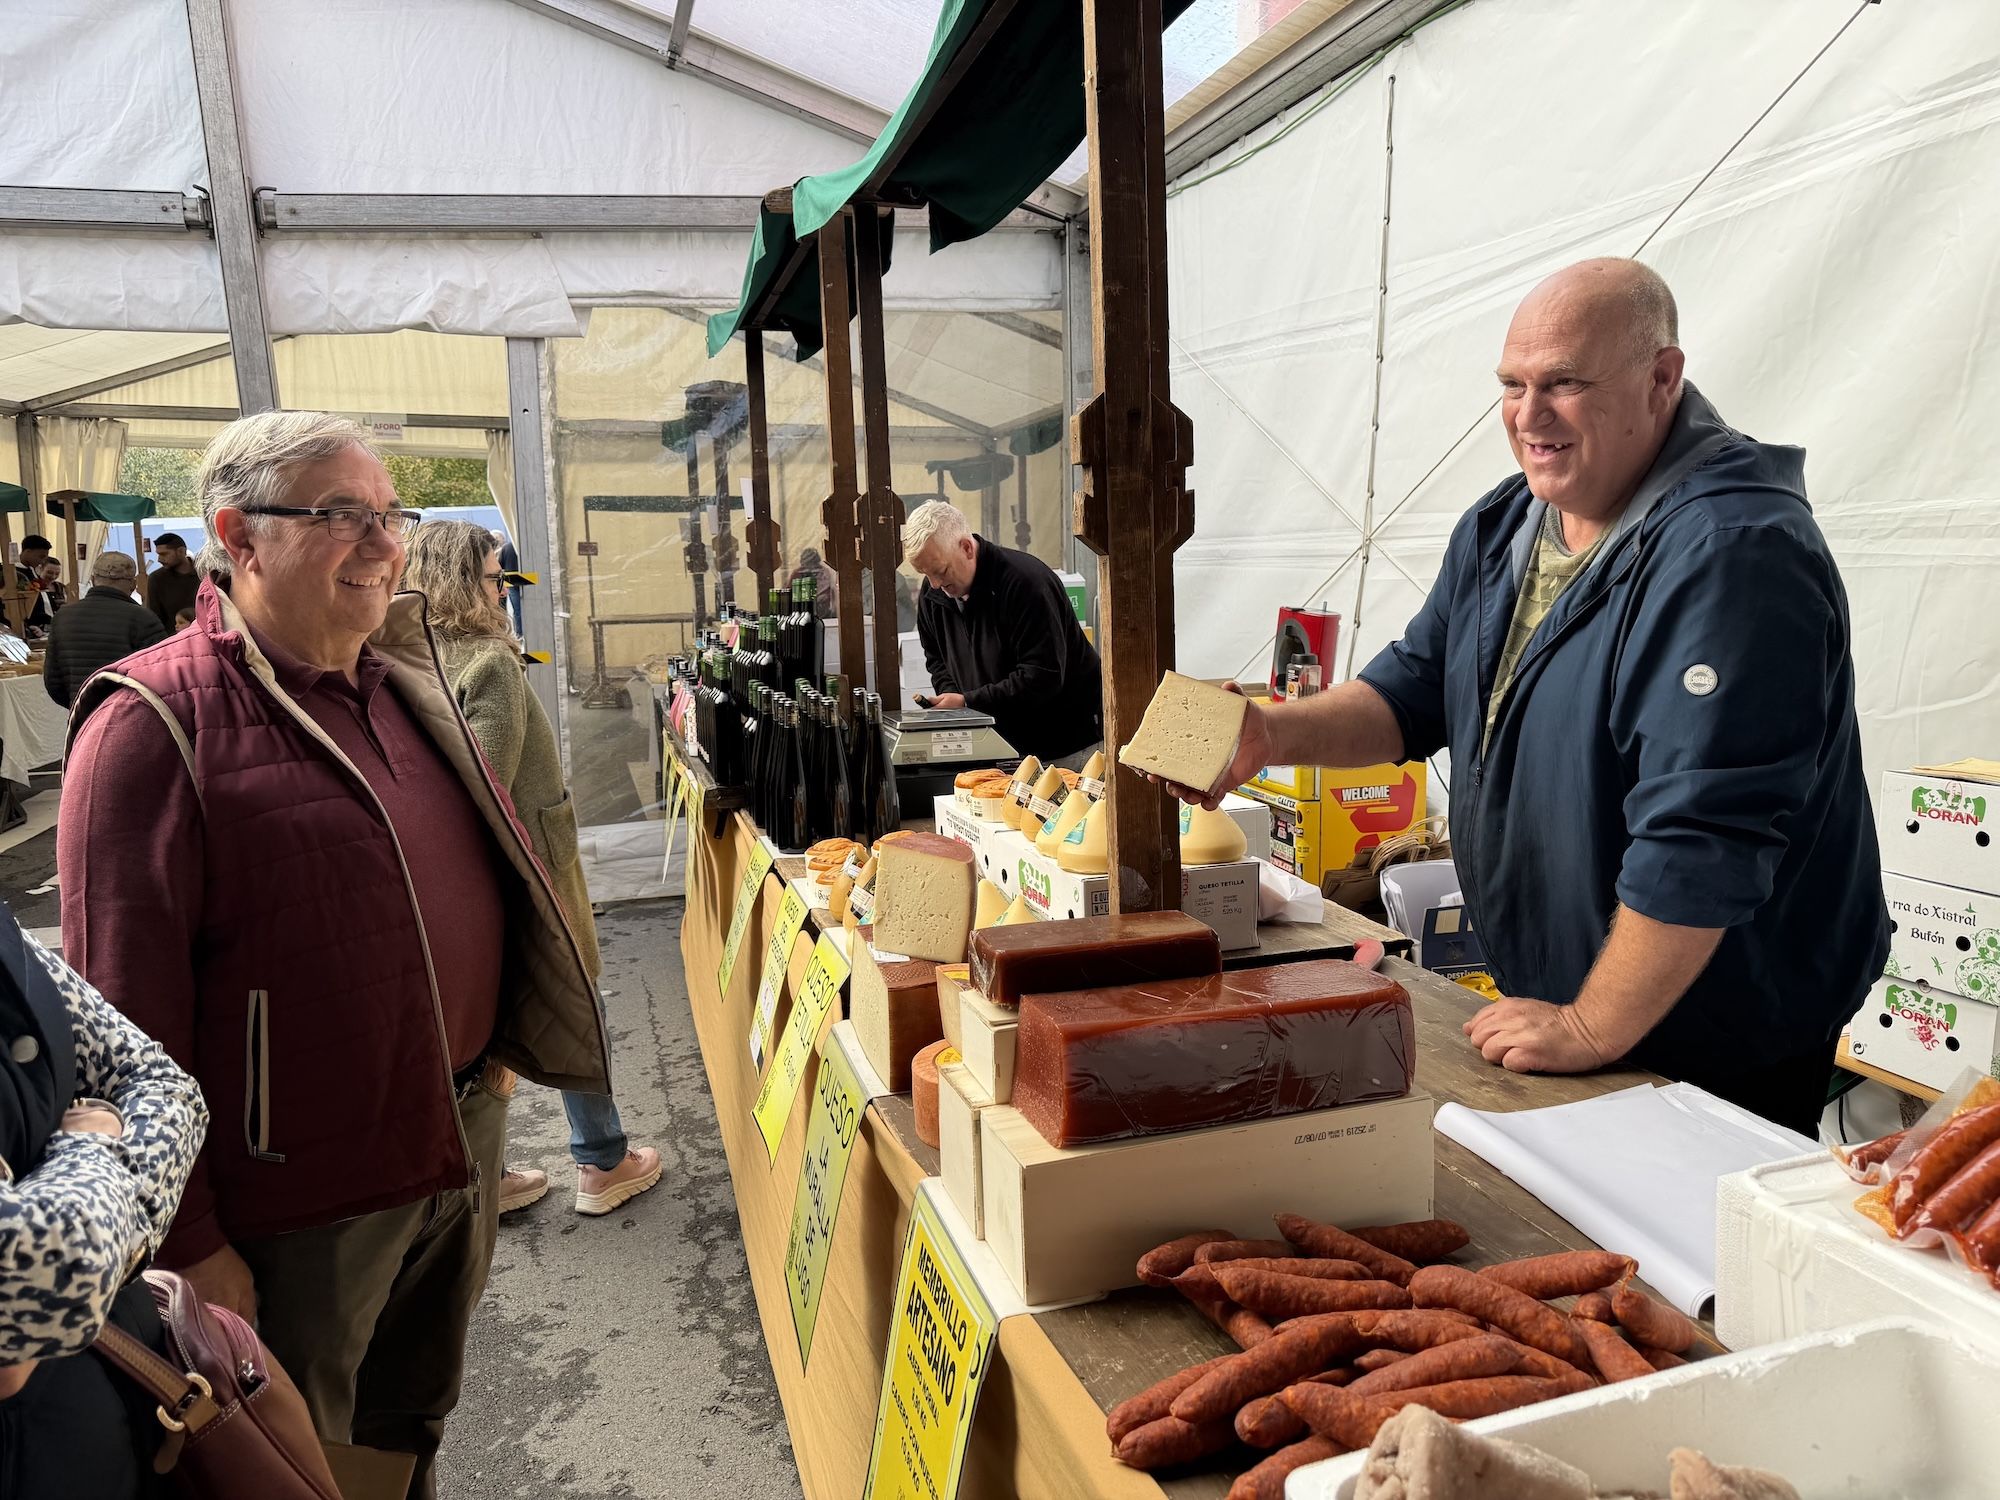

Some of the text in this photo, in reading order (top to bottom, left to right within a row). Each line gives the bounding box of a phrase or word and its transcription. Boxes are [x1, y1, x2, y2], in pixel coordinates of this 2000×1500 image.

[374, 423, 400, 431] AFORO
[1342, 785, 1390, 801] WELCOME
[1917, 806, 1979, 826] LORAN
[1199, 882, 1219, 890] QUESO
[1893, 900, 1976, 927] rra do Xistral
[1911, 927, 1945, 945] Bufón
[806, 956, 835, 1012] QUESO
[793, 995, 814, 1050] TETILLA
[1890, 1005, 1950, 1033] LORAN
[820, 1058, 853, 1149] QUESO
[1294, 1132, 1327, 1145] 07/08/27
[1346, 1125, 1366, 1137] 25219
[820, 1136, 829, 1177] LA
[803, 1149, 830, 1249] MURALLA
[805, 1216, 815, 1258] DE
[795, 1240, 811, 1309] LUGO
[918, 1242, 967, 1352] MEMBRILLO
[906, 1280, 956, 1407] ARTESANO
[907, 1344, 939, 1429] CASERO NORMAL
[891, 1380, 909, 1430] CASERO
[908, 1425, 920, 1459] CON
[912, 1466, 920, 1493] KG
